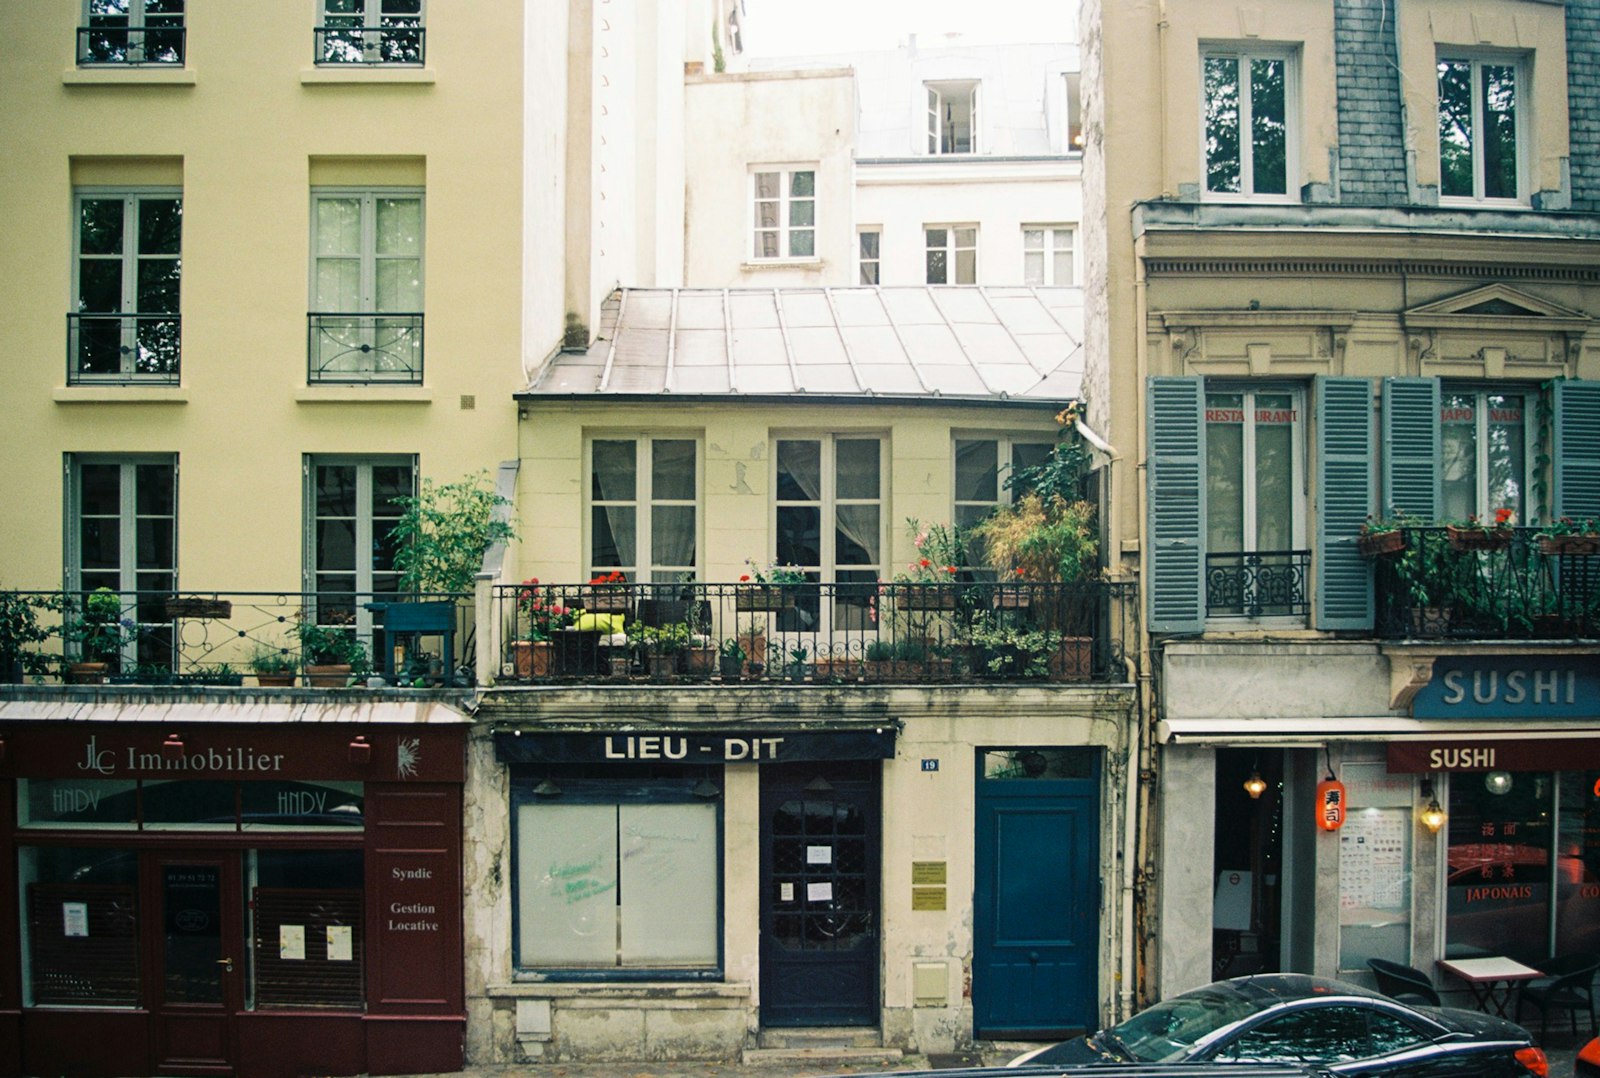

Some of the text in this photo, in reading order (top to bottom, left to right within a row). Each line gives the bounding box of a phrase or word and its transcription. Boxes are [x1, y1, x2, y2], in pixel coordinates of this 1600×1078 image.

[1443, 670, 1576, 704] SUSHI
[605, 736, 688, 760] LIEU
[724, 737, 784, 760] DIT
[925, 760, 936, 770] 19
[1430, 748, 1496, 769] SUSHI
[392, 867, 433, 881] Syndic
[1466, 886, 1532, 903] JAPONAIS
[390, 902, 436, 914] Gestion
[388, 919, 439, 931] Locative
